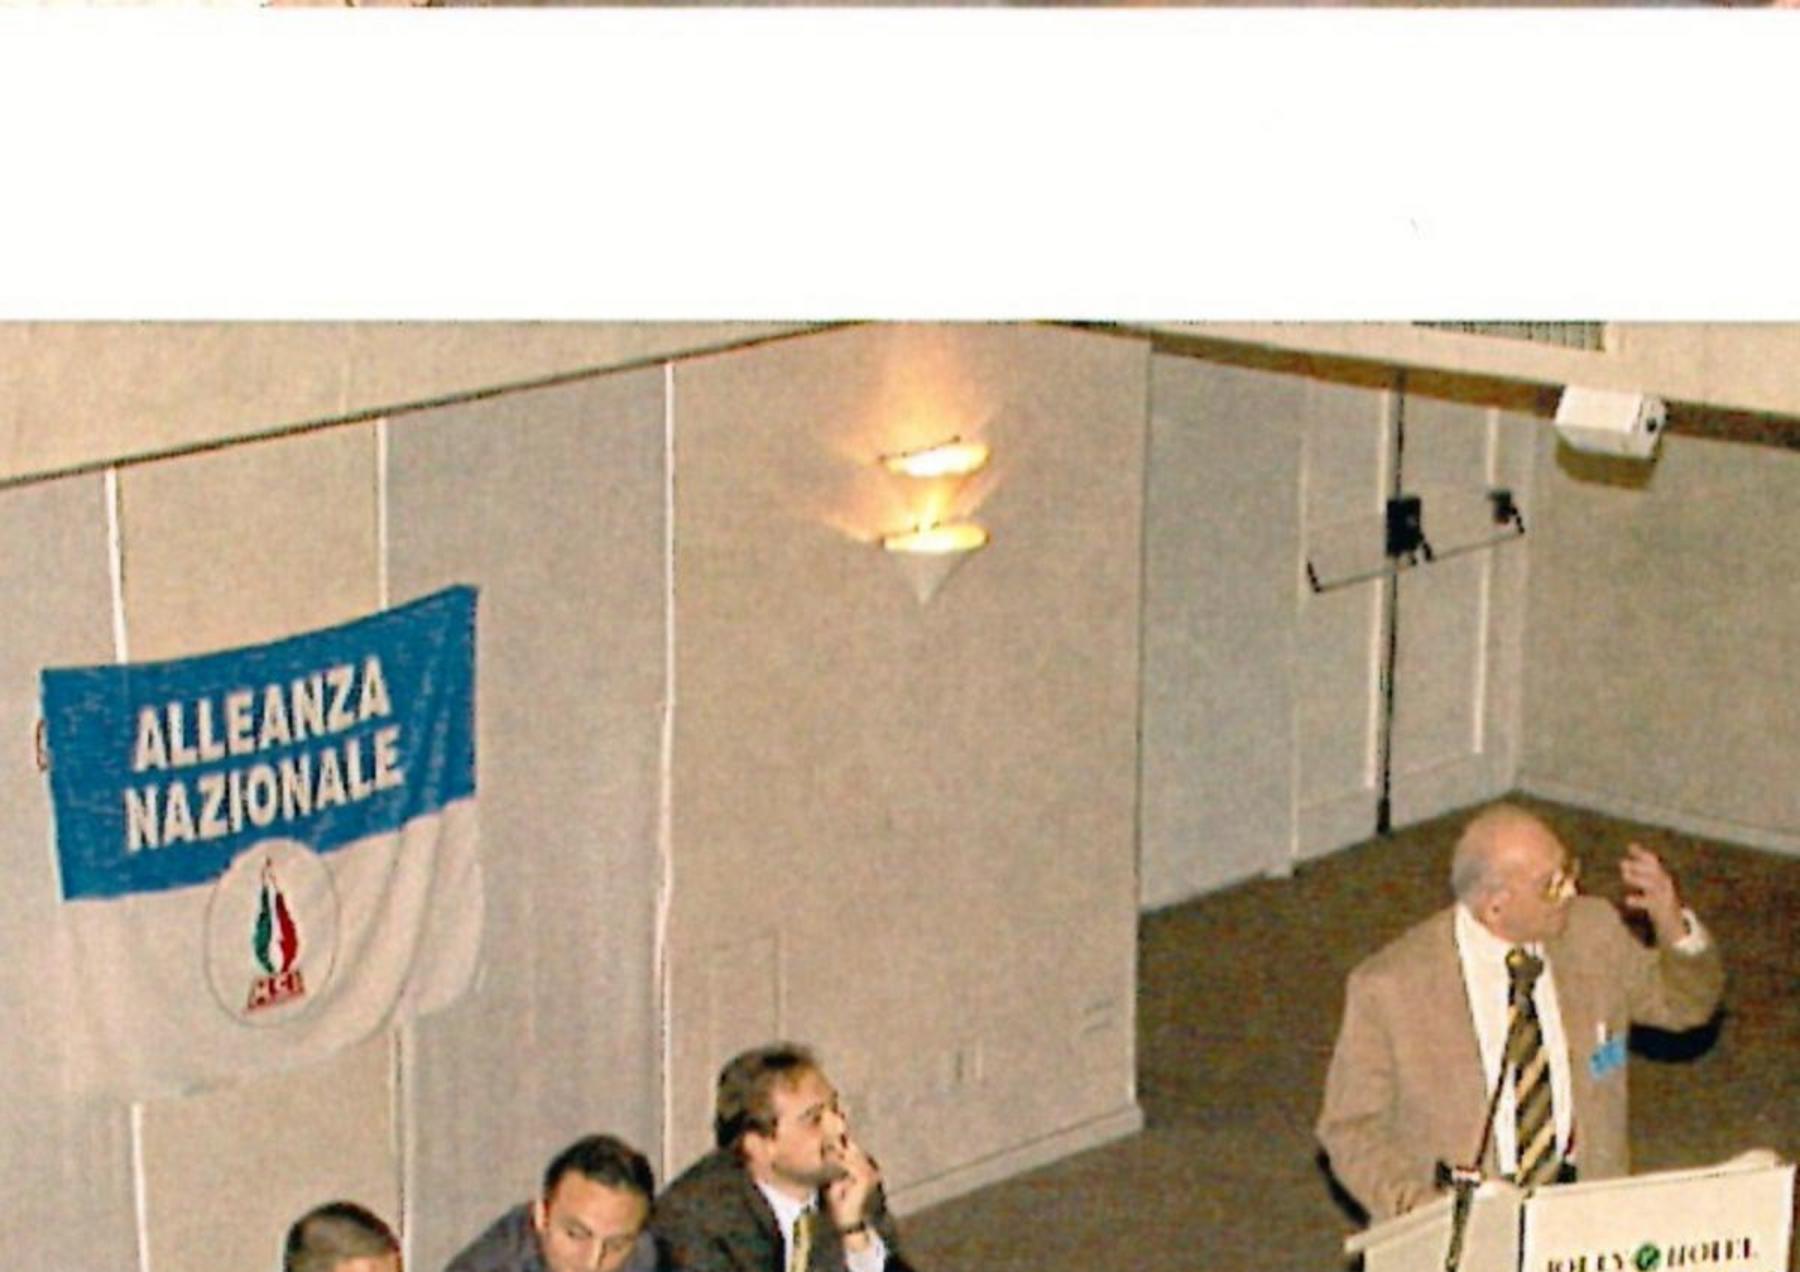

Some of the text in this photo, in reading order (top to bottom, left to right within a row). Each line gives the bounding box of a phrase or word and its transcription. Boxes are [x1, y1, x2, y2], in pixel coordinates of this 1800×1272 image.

[133, 655, 392, 772] ALLEANZA
[124, 725, 405, 853] NAZIONALE
[1666, 1236, 1759, 1268] HOTEL
